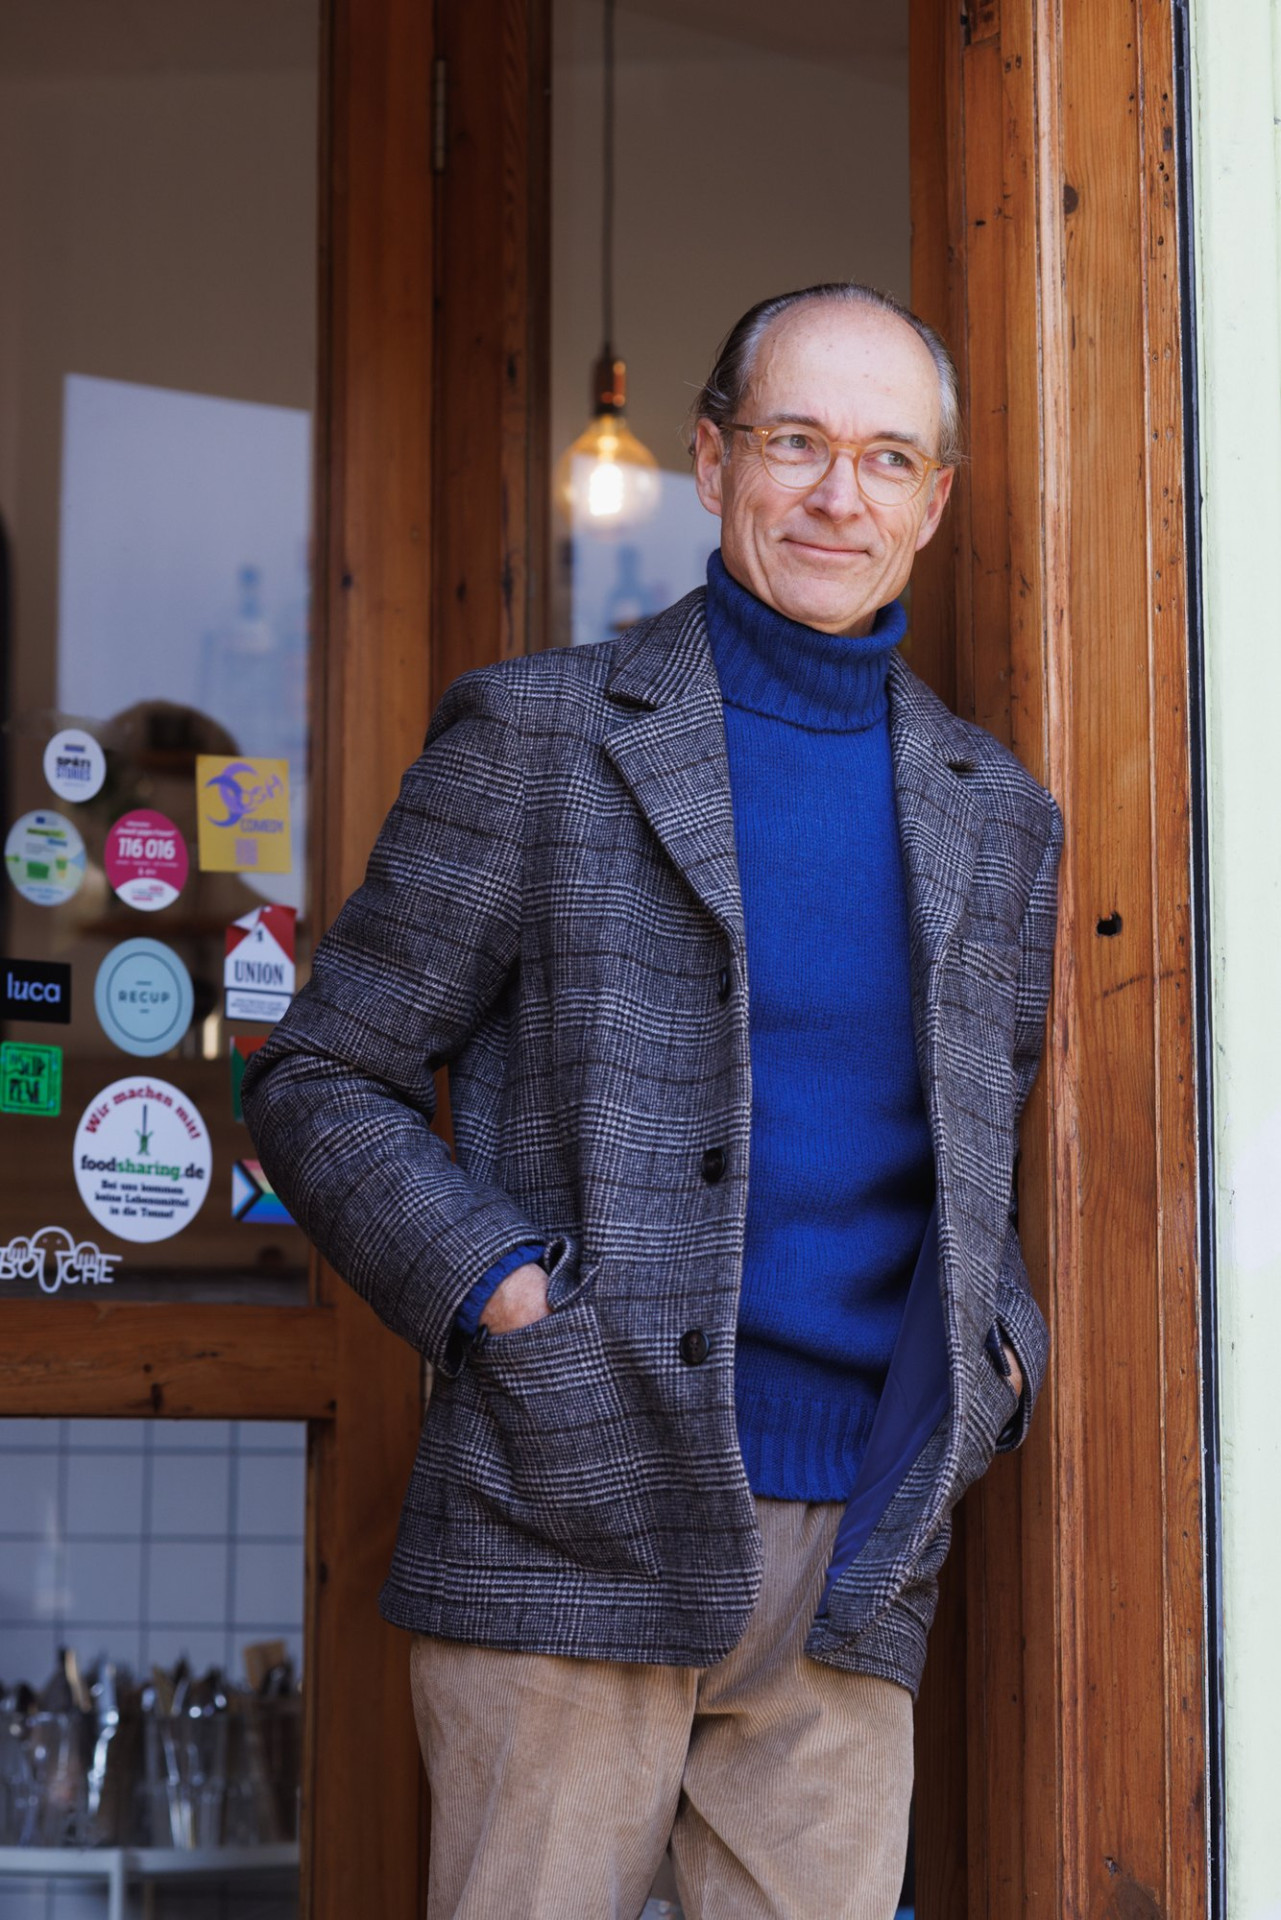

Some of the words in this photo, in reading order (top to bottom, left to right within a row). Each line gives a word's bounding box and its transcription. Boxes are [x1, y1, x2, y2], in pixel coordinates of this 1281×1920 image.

[118, 837, 143, 858] 116
[145, 838, 175, 860] 016
[234, 960, 284, 986] UNION
[7, 971, 61, 1002] luca
[118, 989, 170, 1004] RECUP
[85, 1103, 109, 1133] Wir
[113, 1085, 173, 1107] machen
[176, 1107, 201, 1140] mit!
[81, 1155, 204, 1181] foodsharing.de
[121, 1183, 138, 1191] uns
